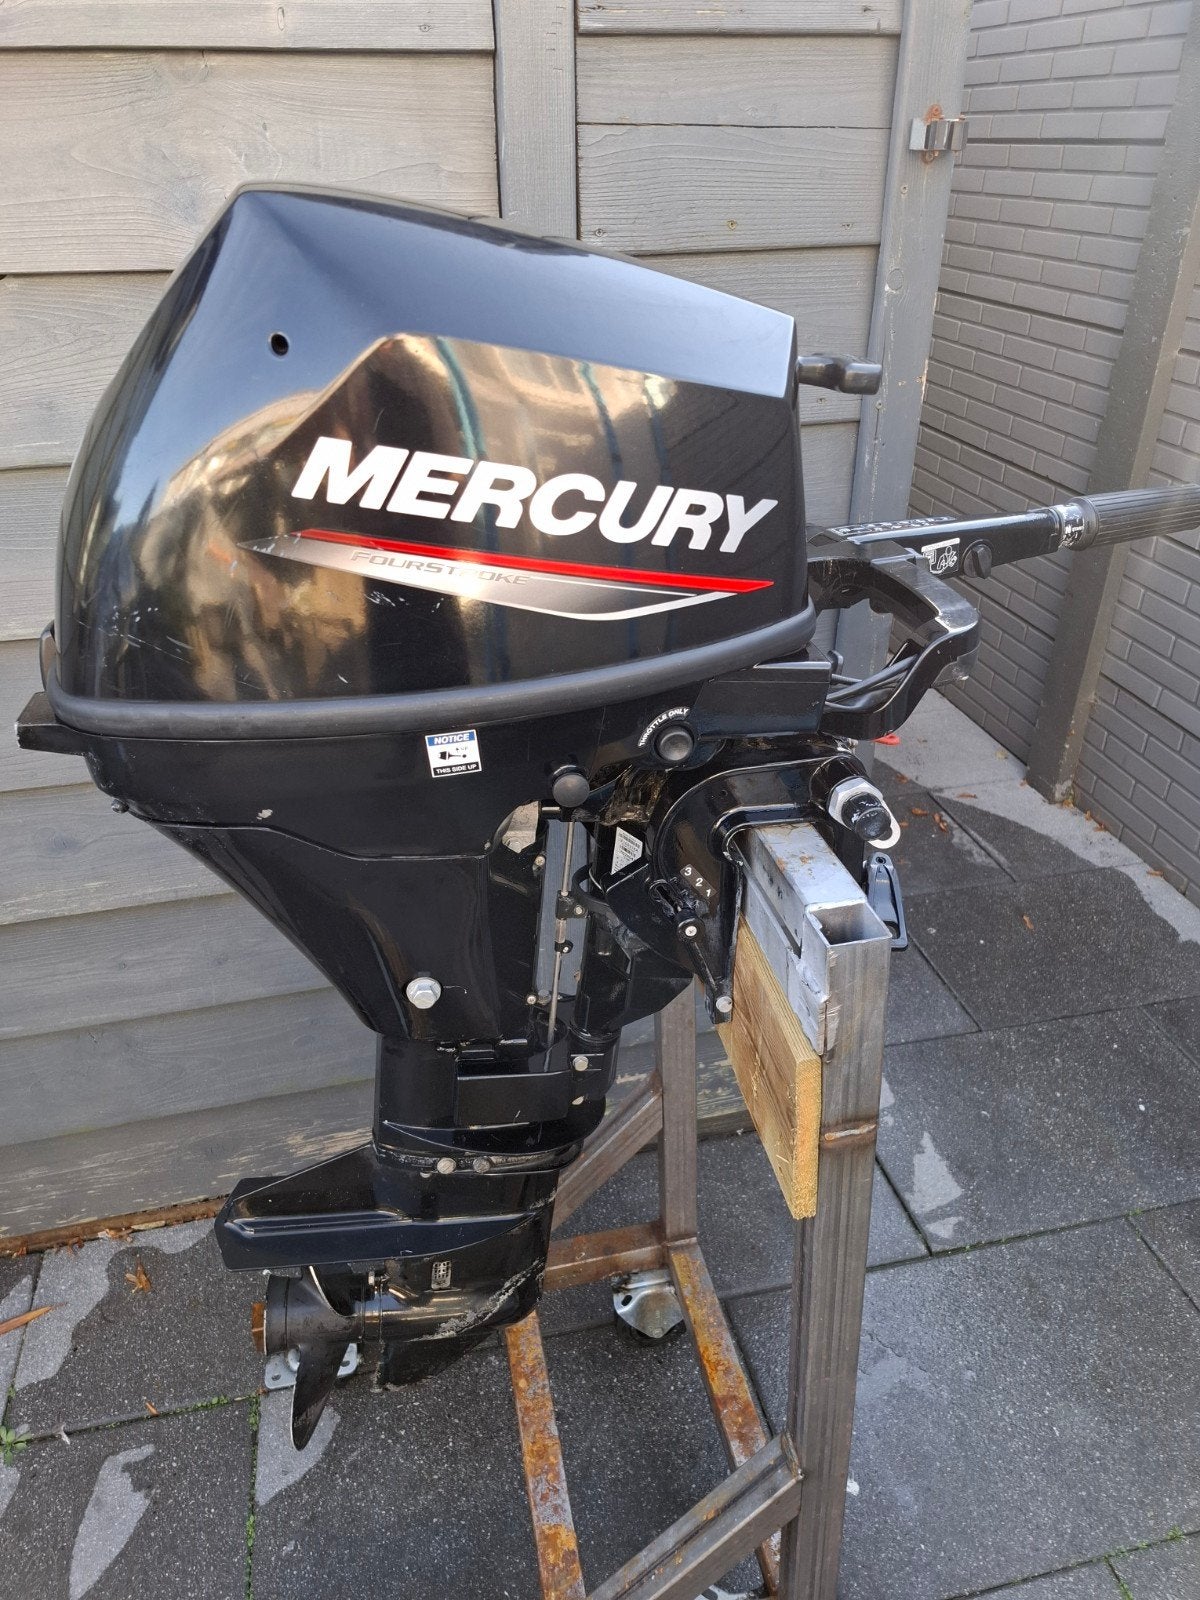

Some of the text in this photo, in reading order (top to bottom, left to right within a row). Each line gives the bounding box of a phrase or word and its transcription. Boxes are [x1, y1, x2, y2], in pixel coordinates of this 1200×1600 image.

[291, 436, 778, 553] MERCURY
[350, 550, 532, 585] FOURSTOKE
[638, 707, 690, 747] THROTTLE ONLY
[434, 733, 470, 744] NOTICE
[452, 765, 467, 773] SIDE
[684, 867, 692, 876] 3
[695, 877, 703, 887] 2
[706, 888, 712, 897] 1
